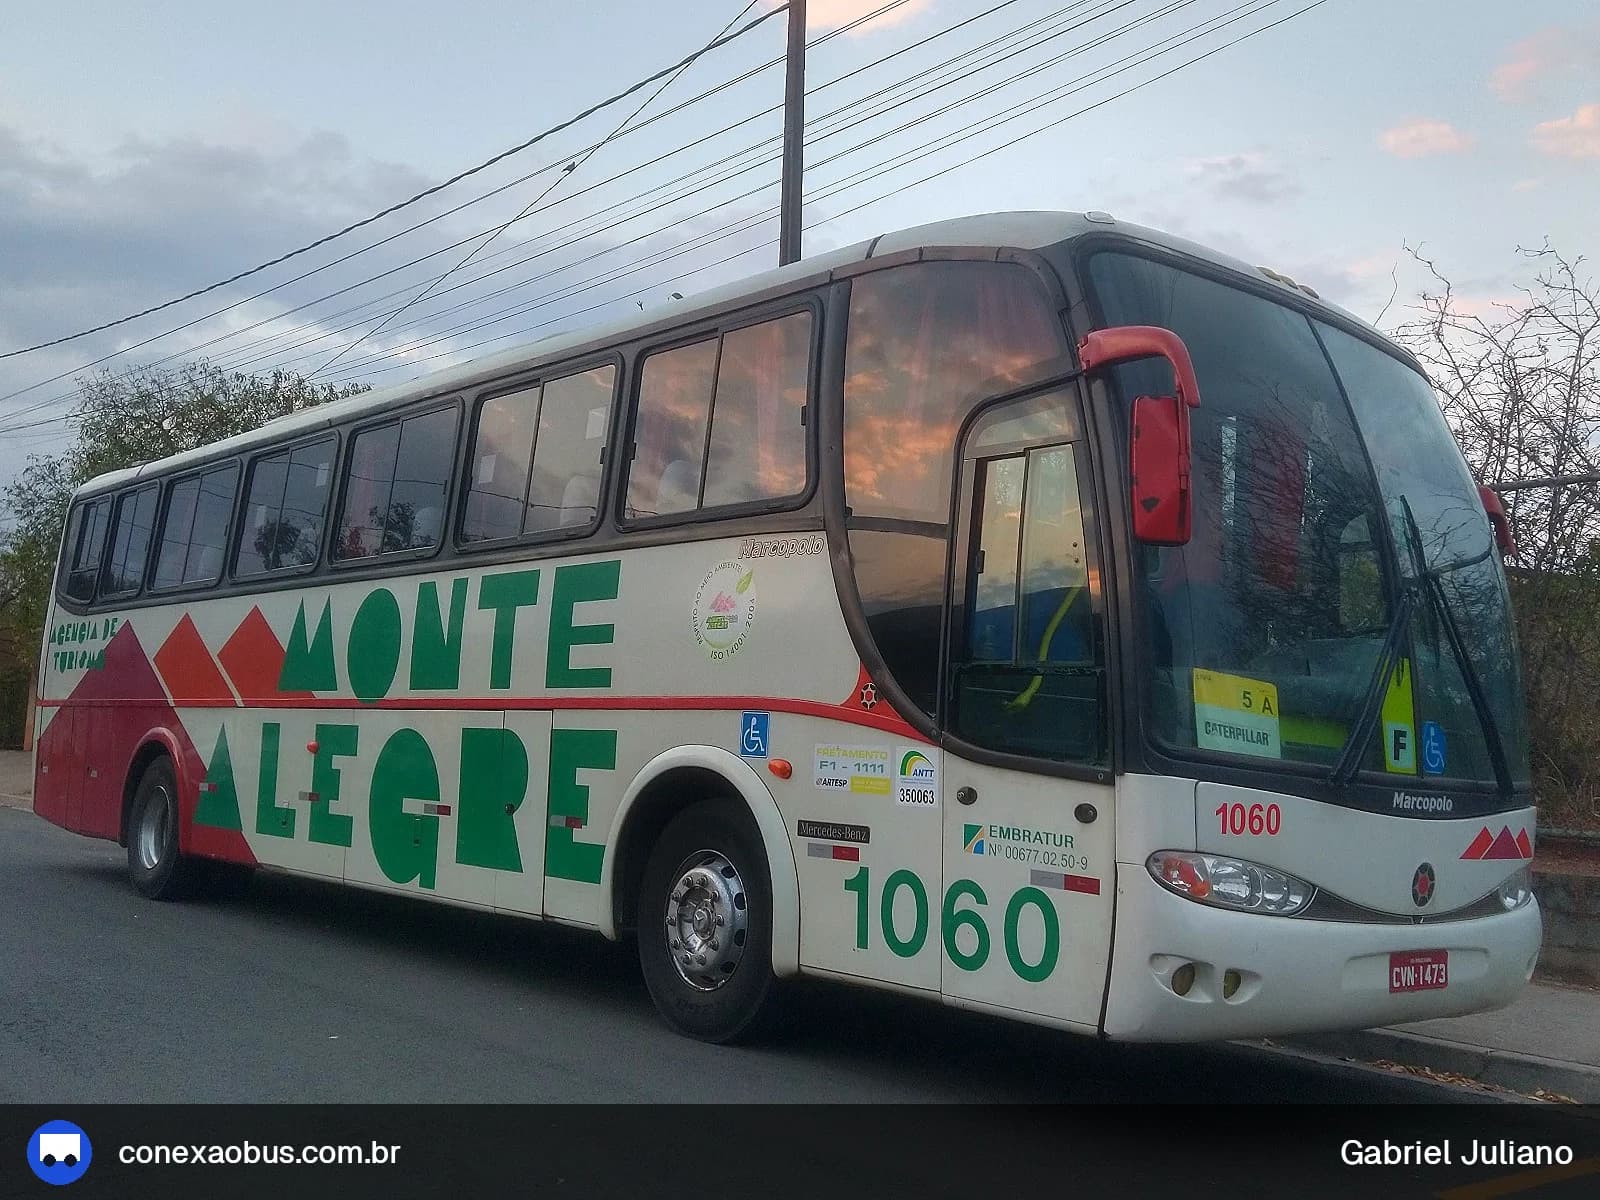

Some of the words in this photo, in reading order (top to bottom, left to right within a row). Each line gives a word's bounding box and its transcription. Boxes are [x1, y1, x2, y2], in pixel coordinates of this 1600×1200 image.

[738, 535, 824, 559] Marcopolo
[102, 617, 119, 641] DE
[277, 559, 621, 704] MONTE
[710, 650, 724, 660] ISO
[1242, 690, 1253, 709] 5
[1204, 721, 1269, 746] CATERPILLAR
[1393, 729, 1408, 761] F
[816, 747, 888, 760] FRETAMENTO
[854, 762, 884, 774] 1111
[912, 768, 935, 778] ANTT
[822, 778, 848, 787] ARTESP
[193, 722, 618, 890] ALEGRE
[899, 788, 935, 804] 350063
[1392, 791, 1453, 812] Marcopolo
[1215, 802, 1281, 836] 1060
[800, 821, 867, 841] Mercedes-Benz
[989, 825, 1074, 848] EMBRATUR
[1005, 845, 1088, 870] 00677.02.50-9
[844, 866, 1060, 983] 1060
